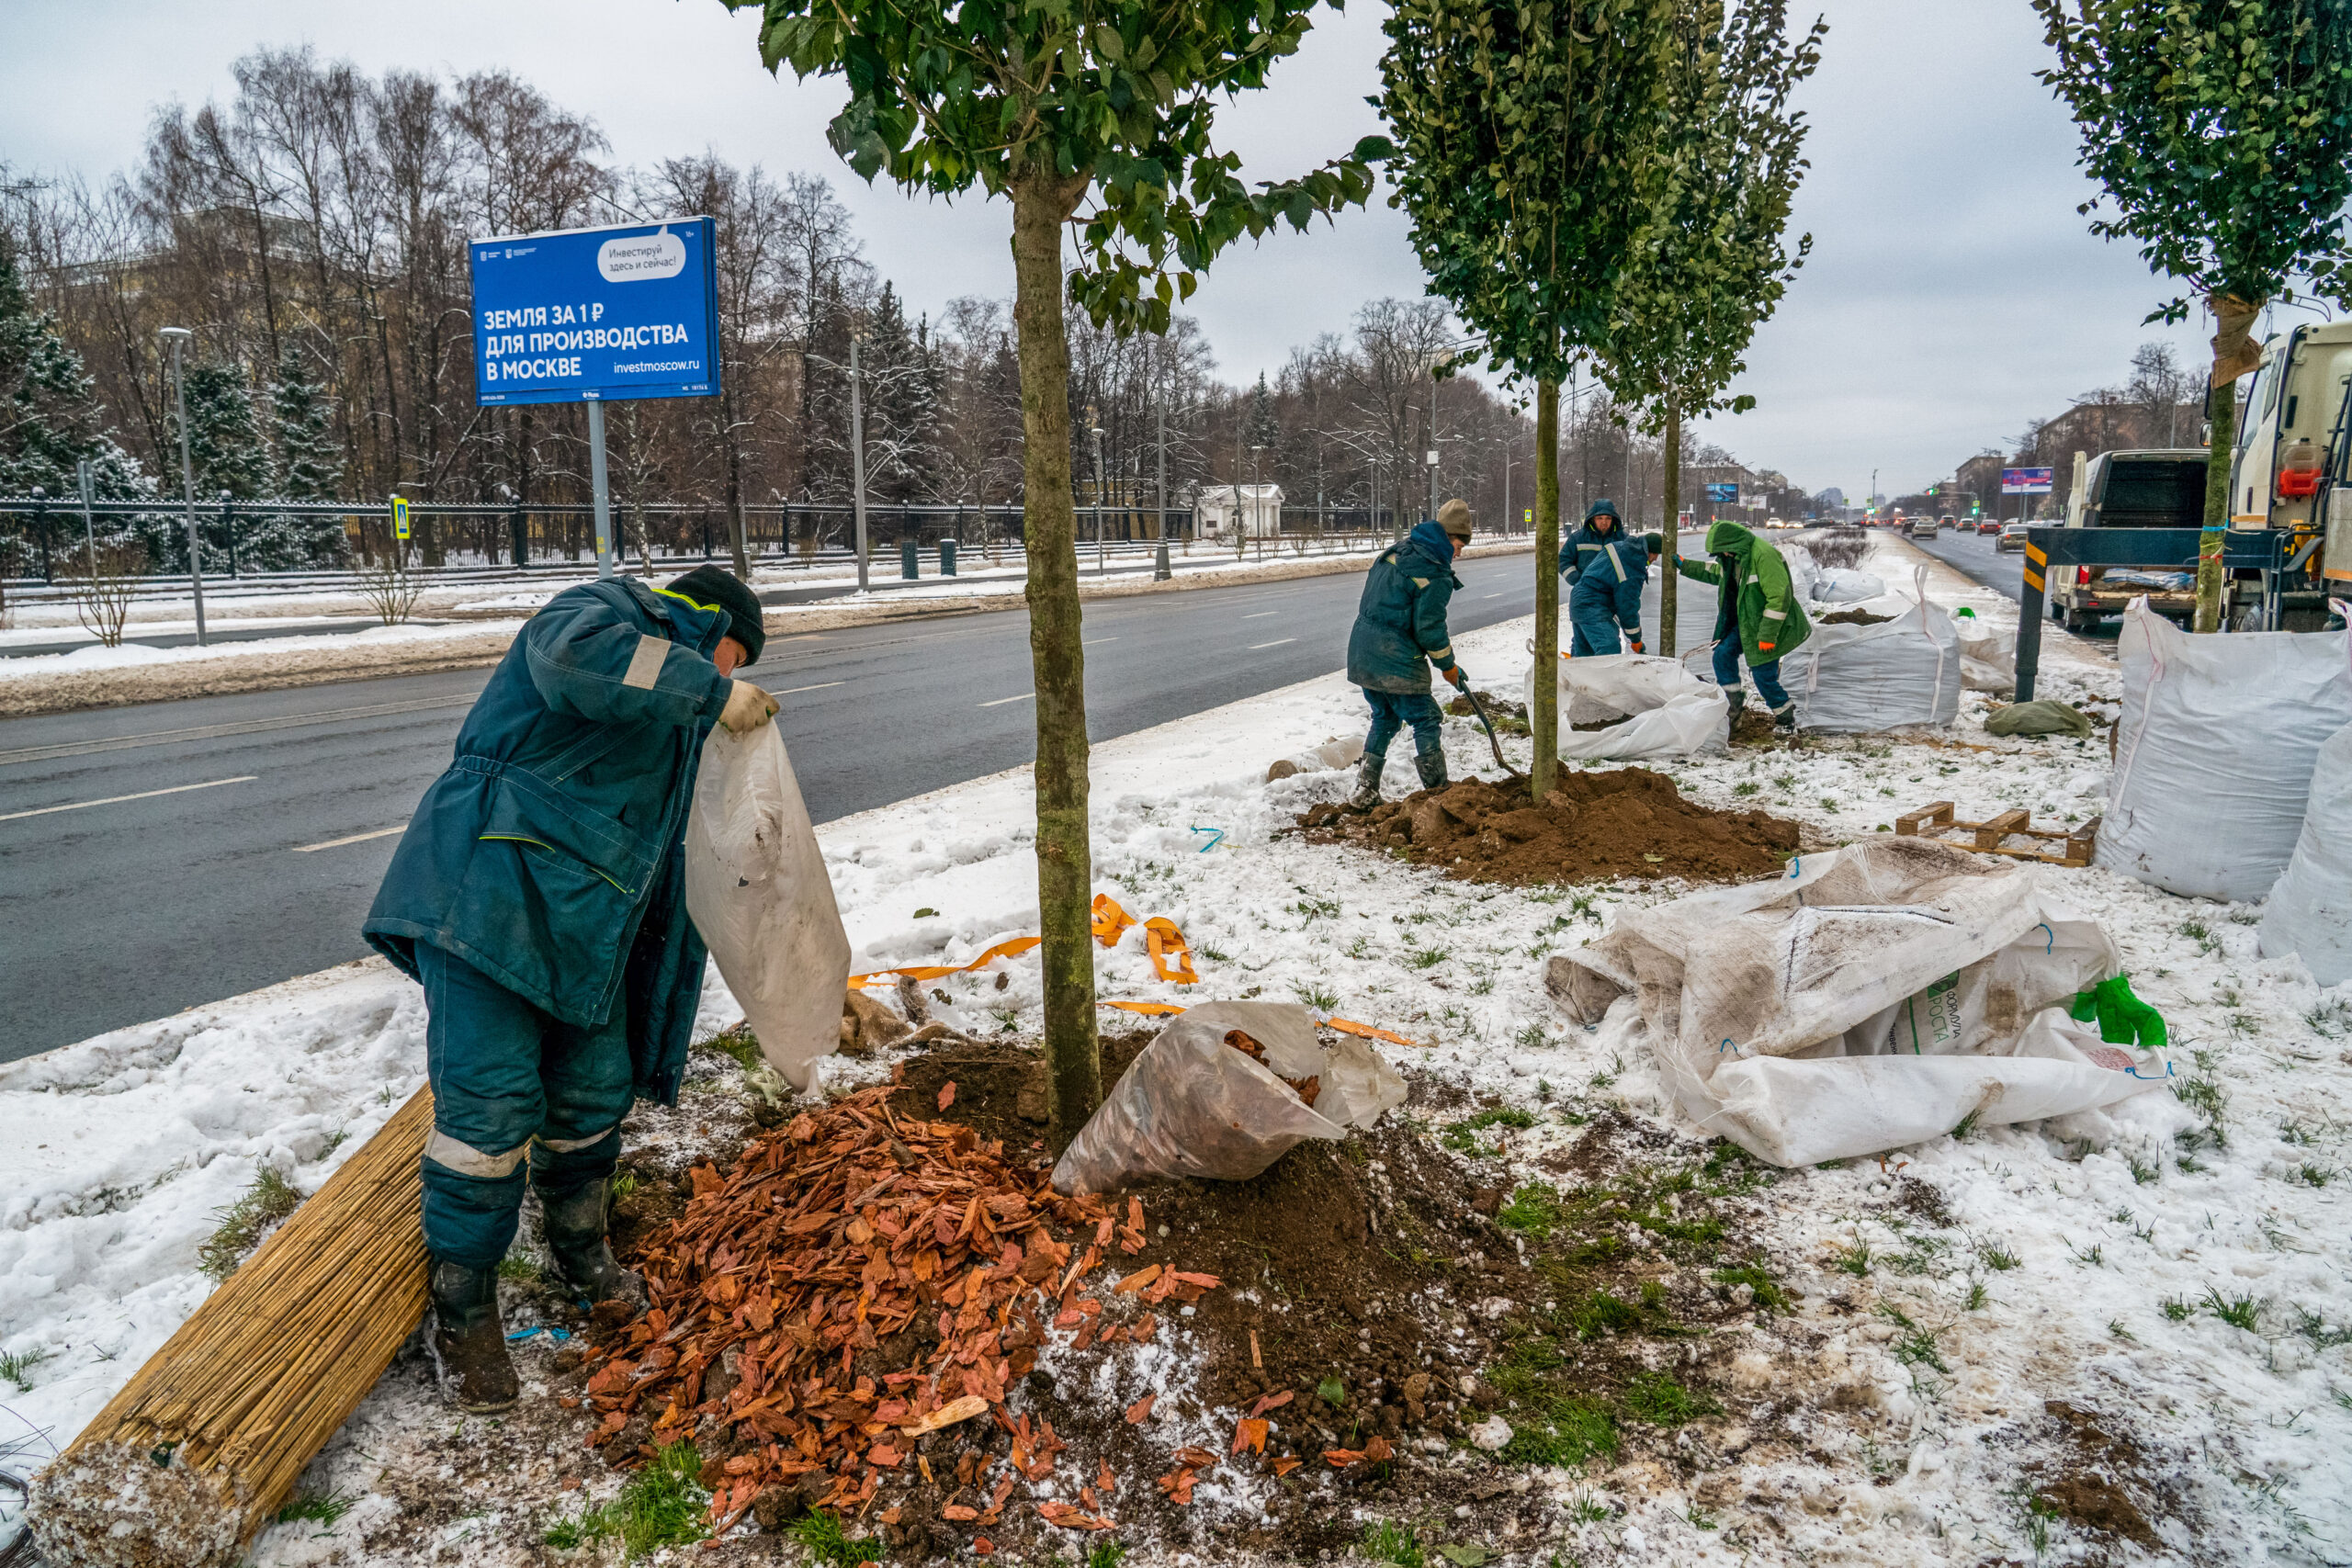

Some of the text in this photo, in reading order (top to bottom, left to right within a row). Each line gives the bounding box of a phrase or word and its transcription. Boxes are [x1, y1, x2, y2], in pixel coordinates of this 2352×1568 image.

[608, 244, 662, 258] Инвестируй
[609, 262, 633, 272] здесь
[643, 255, 677, 269] сейчас!
[484, 306, 548, 330] ЗЕМЛЯ
[551, 305, 576, 325] ЗА
[579, 303, 587, 323] 1
[485, 323, 689, 359] ДЛЯ ПРОИЗВОДСТВА
[486, 356, 582, 381] В МОСКВЕ
[614, 359, 700, 374] investmoscow.ru
[1928, 997, 1950, 1043] РОСТА
[1945, 990, 1962, 1039] ФОРМУЛА
